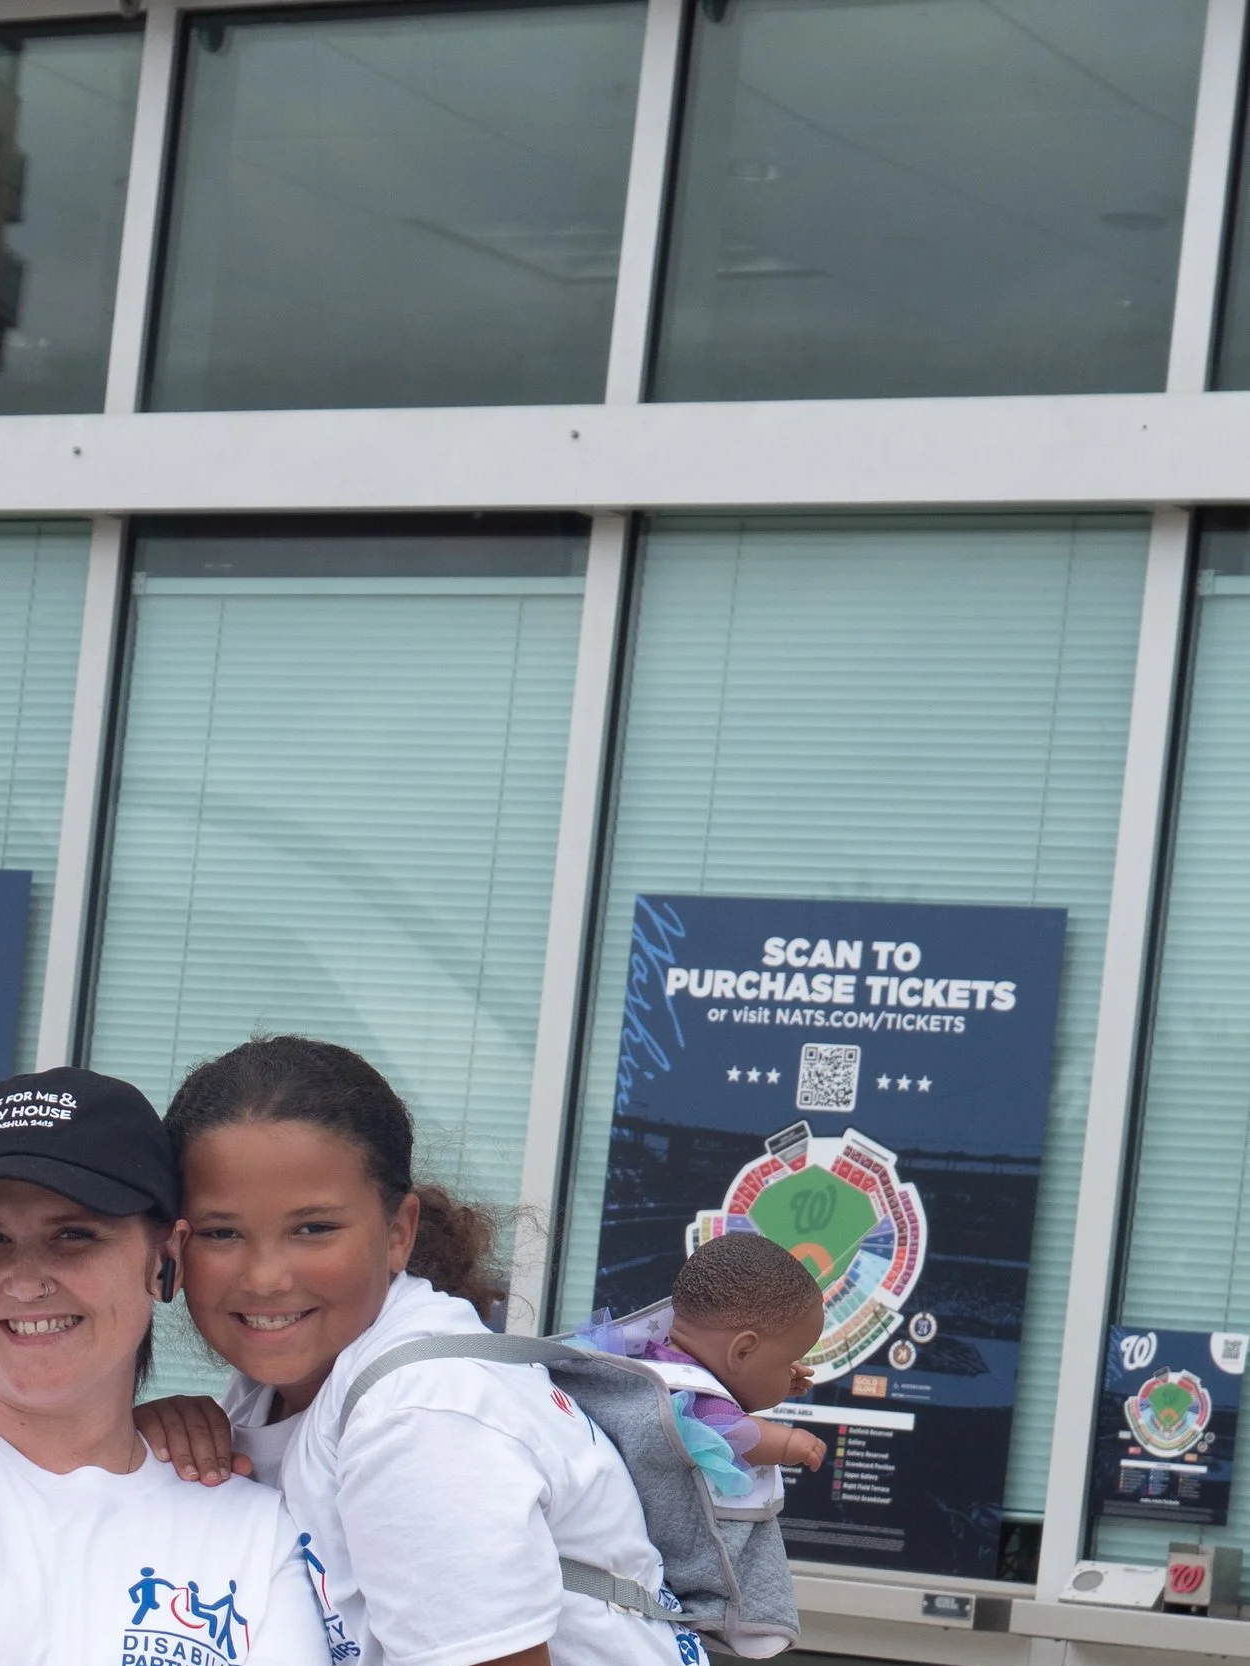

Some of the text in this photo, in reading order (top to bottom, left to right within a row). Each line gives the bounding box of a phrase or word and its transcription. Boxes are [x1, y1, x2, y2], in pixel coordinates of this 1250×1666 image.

[762, 937, 922, 972] SCAN TO
[665, 967, 1017, 1012] PURCHASE TICKETS
[707, 1006, 966, 1034] or visit NATS.COM/TICKETS
[5, 1091, 32, 1104] FOR
[11, 1105, 71, 1120] HOUSE
